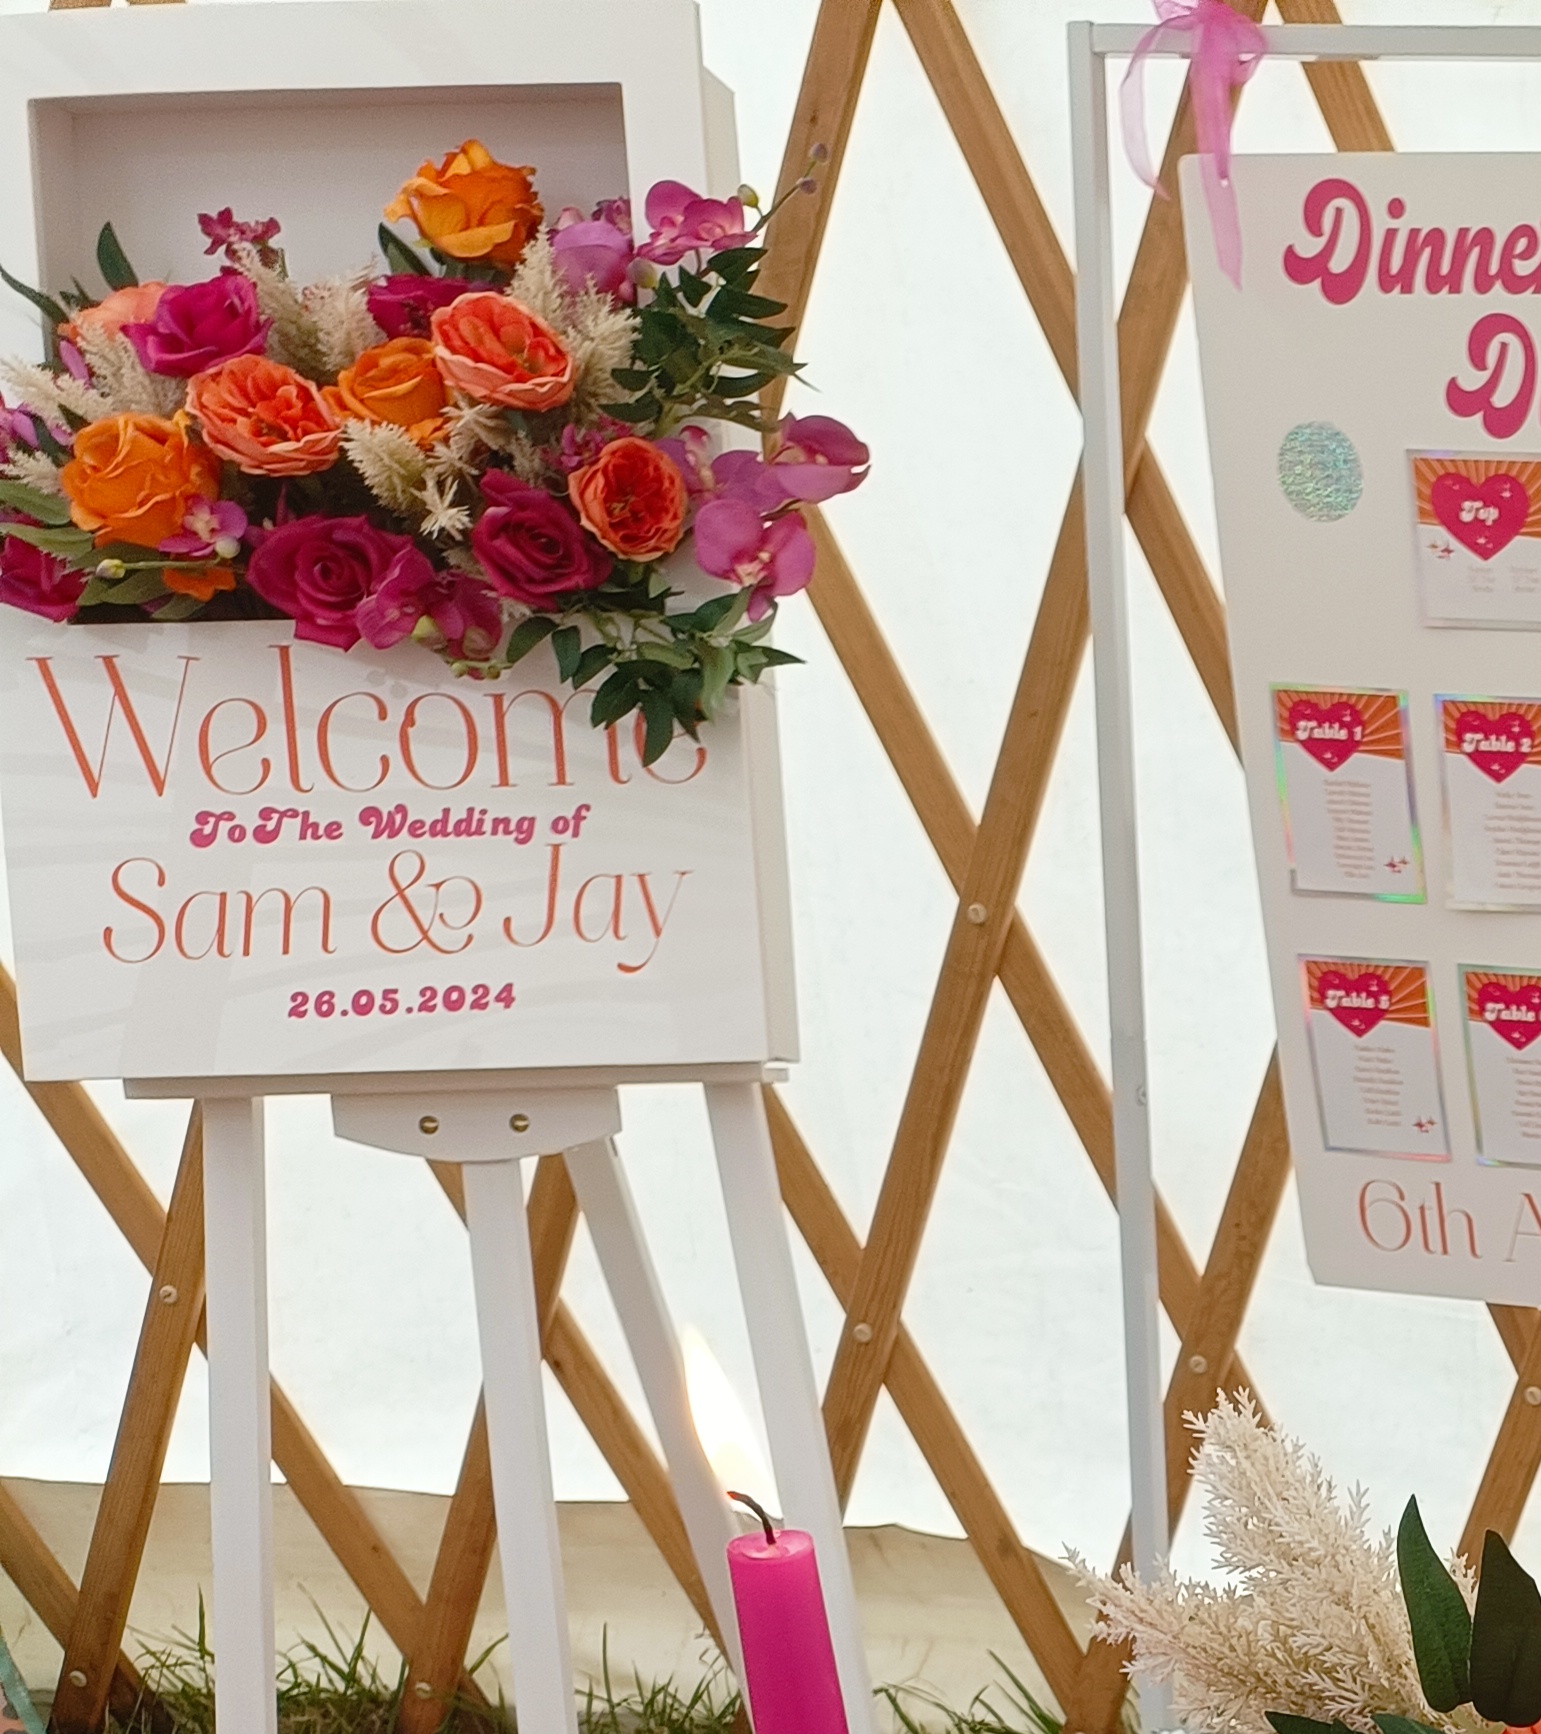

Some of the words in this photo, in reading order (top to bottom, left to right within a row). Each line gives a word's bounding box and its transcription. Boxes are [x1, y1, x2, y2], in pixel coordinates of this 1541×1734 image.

[1458, 500, 1499, 526] Top
[1295, 720, 1348, 740] Table
[1353, 726, 1363, 741] 1
[1461, 733, 1515, 753] Table
[1517, 738, 1533, 753] 2
[359, 804, 536, 844] Wedding
[551, 804, 591, 838] of
[103, 858, 337, 963] Sam
[370, 849, 483, 955] &
[503, 842, 694, 973] Jay
[287, 983, 516, 1018] 26.05.2024
[1326, 990, 1375, 1009] Table
[1378, 996, 1391, 1010] 5
[1484, 1003, 1536, 1022] Table
[1358, 1179, 1482, 1260] 6th
